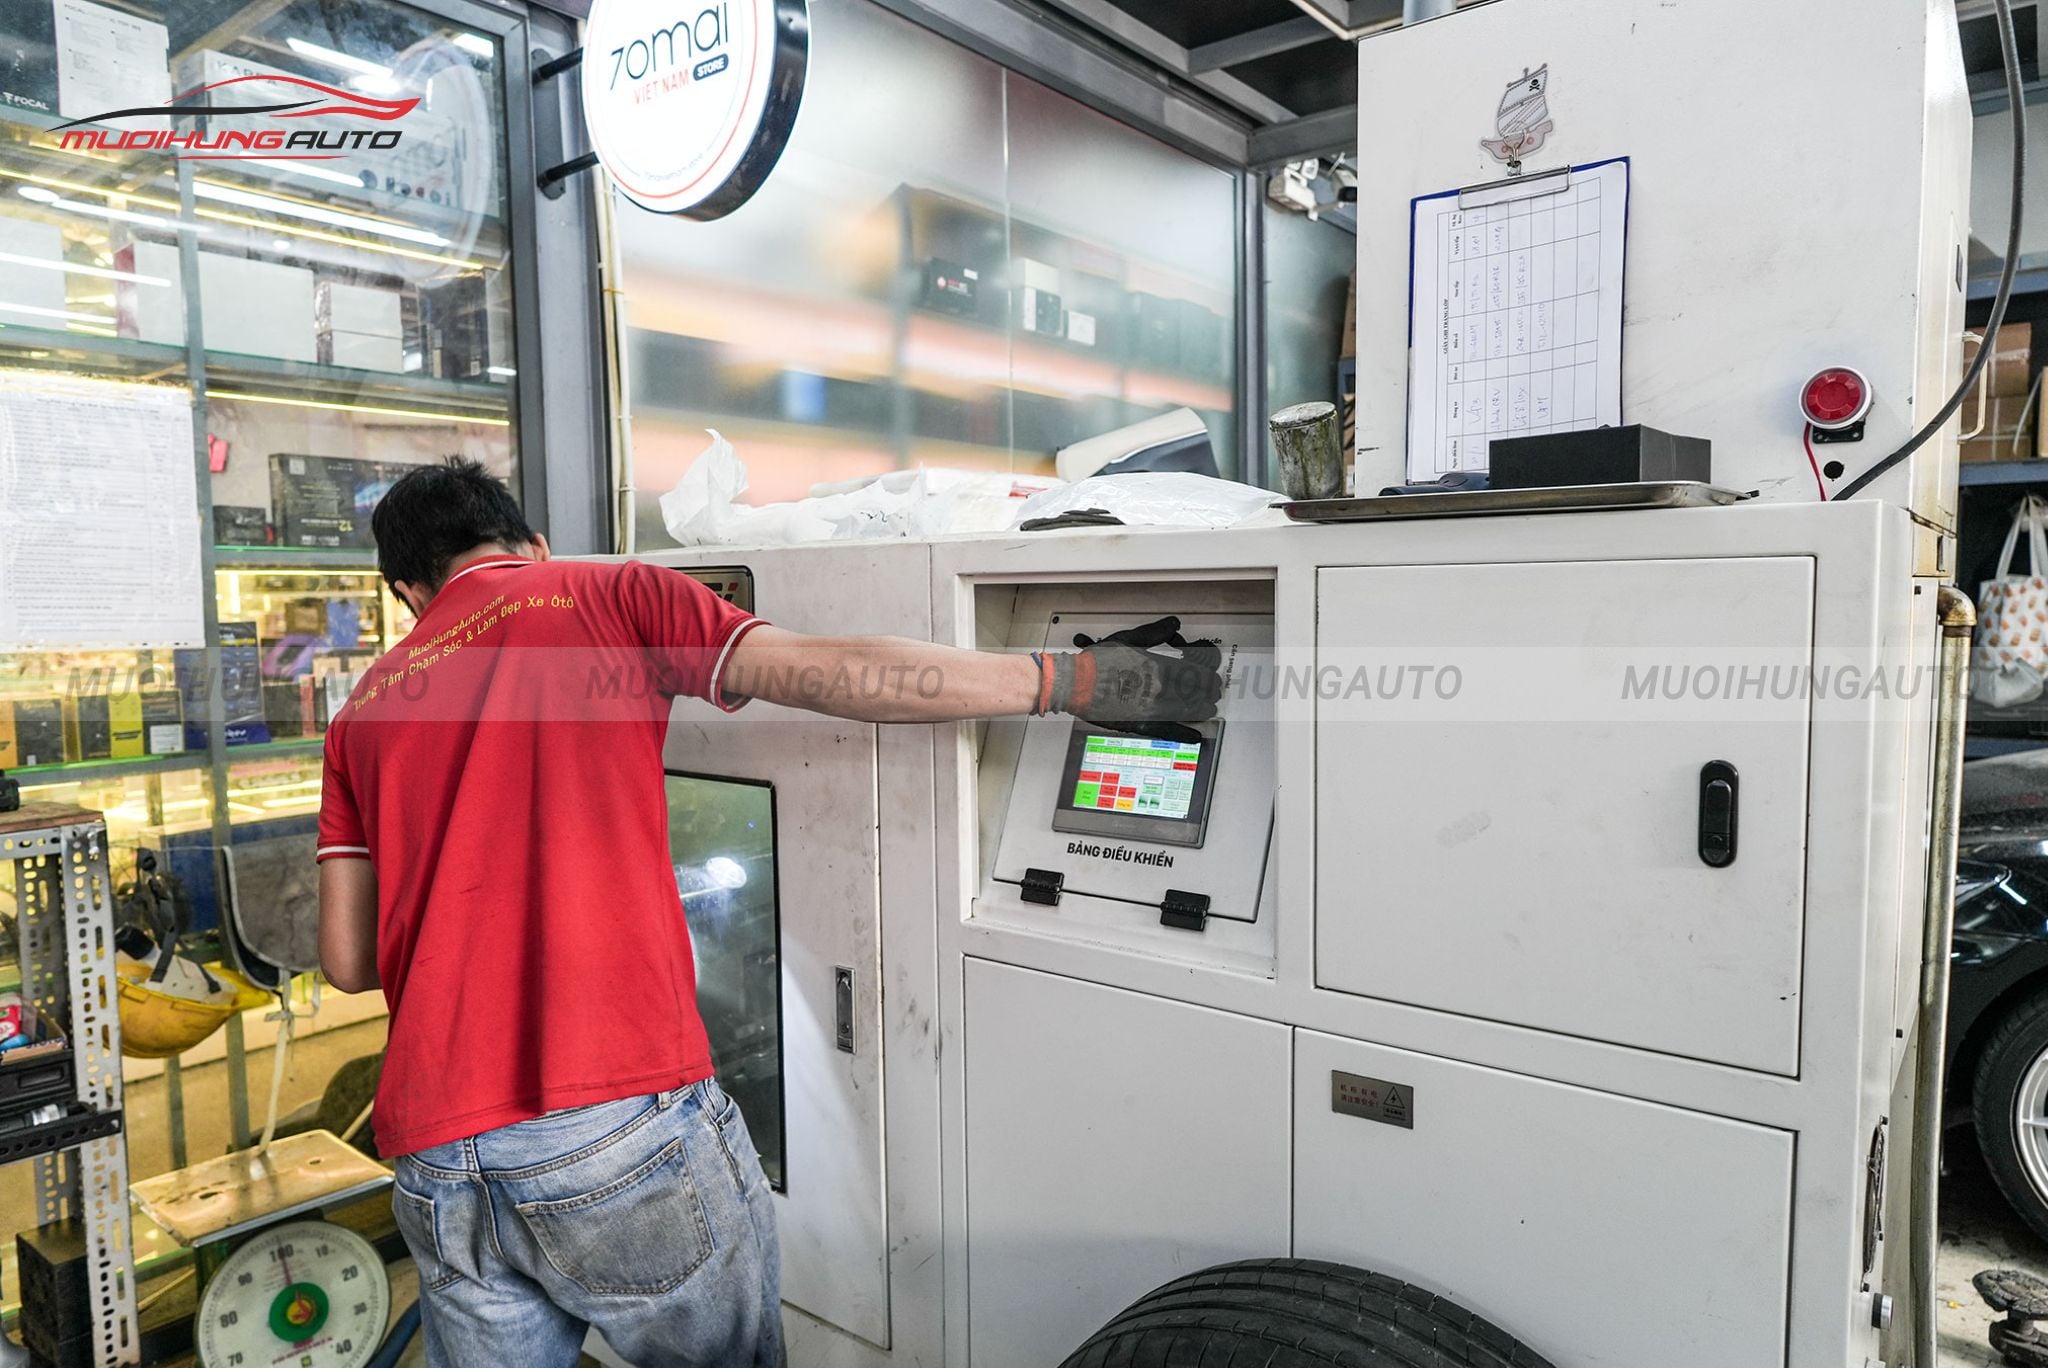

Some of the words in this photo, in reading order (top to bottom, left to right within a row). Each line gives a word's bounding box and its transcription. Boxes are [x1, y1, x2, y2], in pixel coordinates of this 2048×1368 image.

[696, 54, 726, 78] STORE
[14, 95, 50, 110] FOCAL
[408, 595, 505, 660] MuoiHungAuto.com
[353, 686, 379, 713] Trung
[442, 638, 463, 658] Sóc
[465, 630, 475, 642] &
[476, 614, 499, 636] Làm
[500, 599, 522, 618] Đẹp
[527, 595, 544, 609] Xe
[1066, 840, 1100, 858] BẢNG
[1133, 850, 1174, 868] KHIỂN
[269, 1243, 294, 1262] 100
[315, 1244, 329, 1258] 10
[238, 1272, 253, 1287] 90
[341, 1265, 358, 1282] 20
[219, 1310, 238, 1328] 80
[336, 1339, 353, 1355] 40
[228, 1352, 243, 1367] 70
